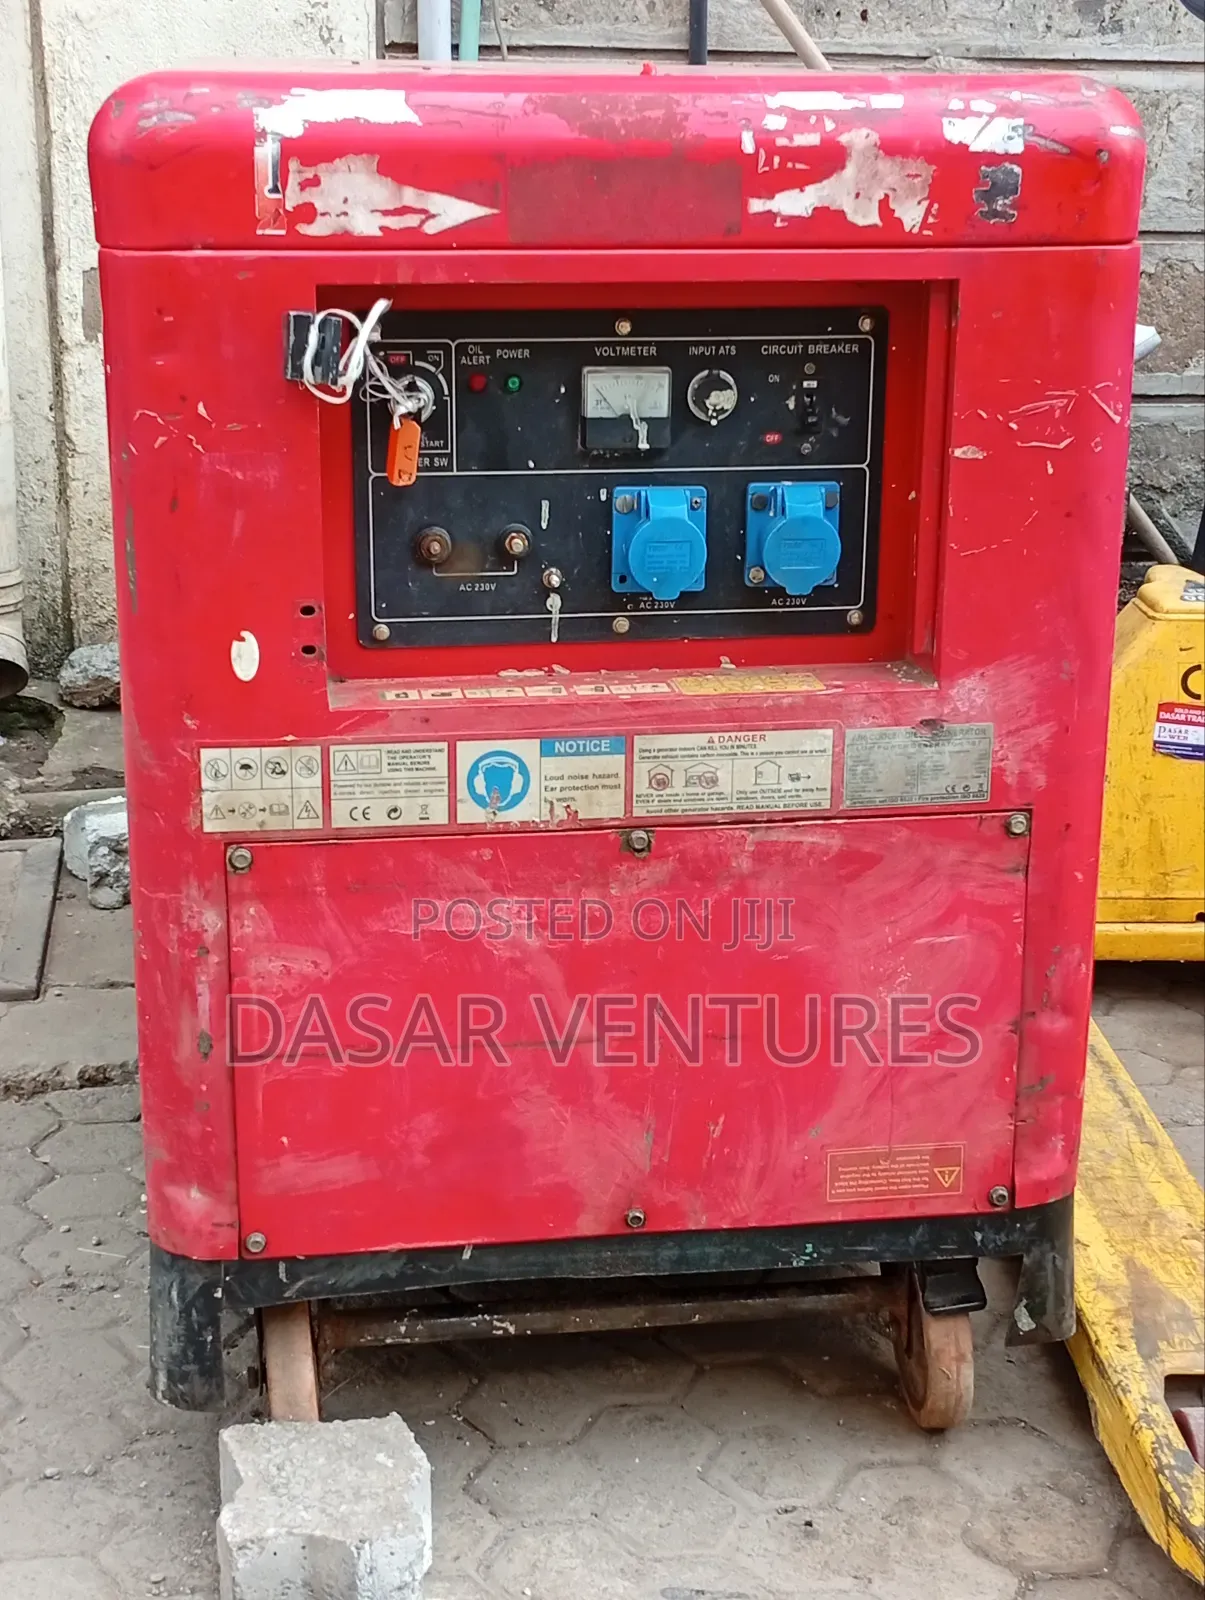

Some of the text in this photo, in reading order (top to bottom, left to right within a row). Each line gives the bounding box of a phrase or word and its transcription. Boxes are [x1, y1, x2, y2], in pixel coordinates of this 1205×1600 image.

[467, 345, 483, 355] OIL
[496, 349, 530, 359] POWER
[594, 346, 657, 357] VOLTMETER
[688, 345, 737, 356] INPUT ATS
[761, 343, 859, 355] CIRCUIT BREAKER
[428, 354, 440, 362] ON
[460, 356, 491, 365] ALERT
[768, 374, 780, 383] ON
[766, 434, 780, 443] OFF
[420, 440, 444, 448] START
[418, 457, 449, 467] ER SW
[459, 583, 497, 591] AC 230V
[639, 601, 676, 609] AC 230V
[771, 598, 807, 606] AC 230V
[1159, 711, 1205, 724] DASAR TRA
[718, 734, 767, 744] DANGER
[554, 740, 611, 753] NOTICE
[568, 773, 589, 781] noise
[592, 773, 620, 781] hazard.
[559, 784, 599, 793] protection
[601, 783, 622, 791] must
